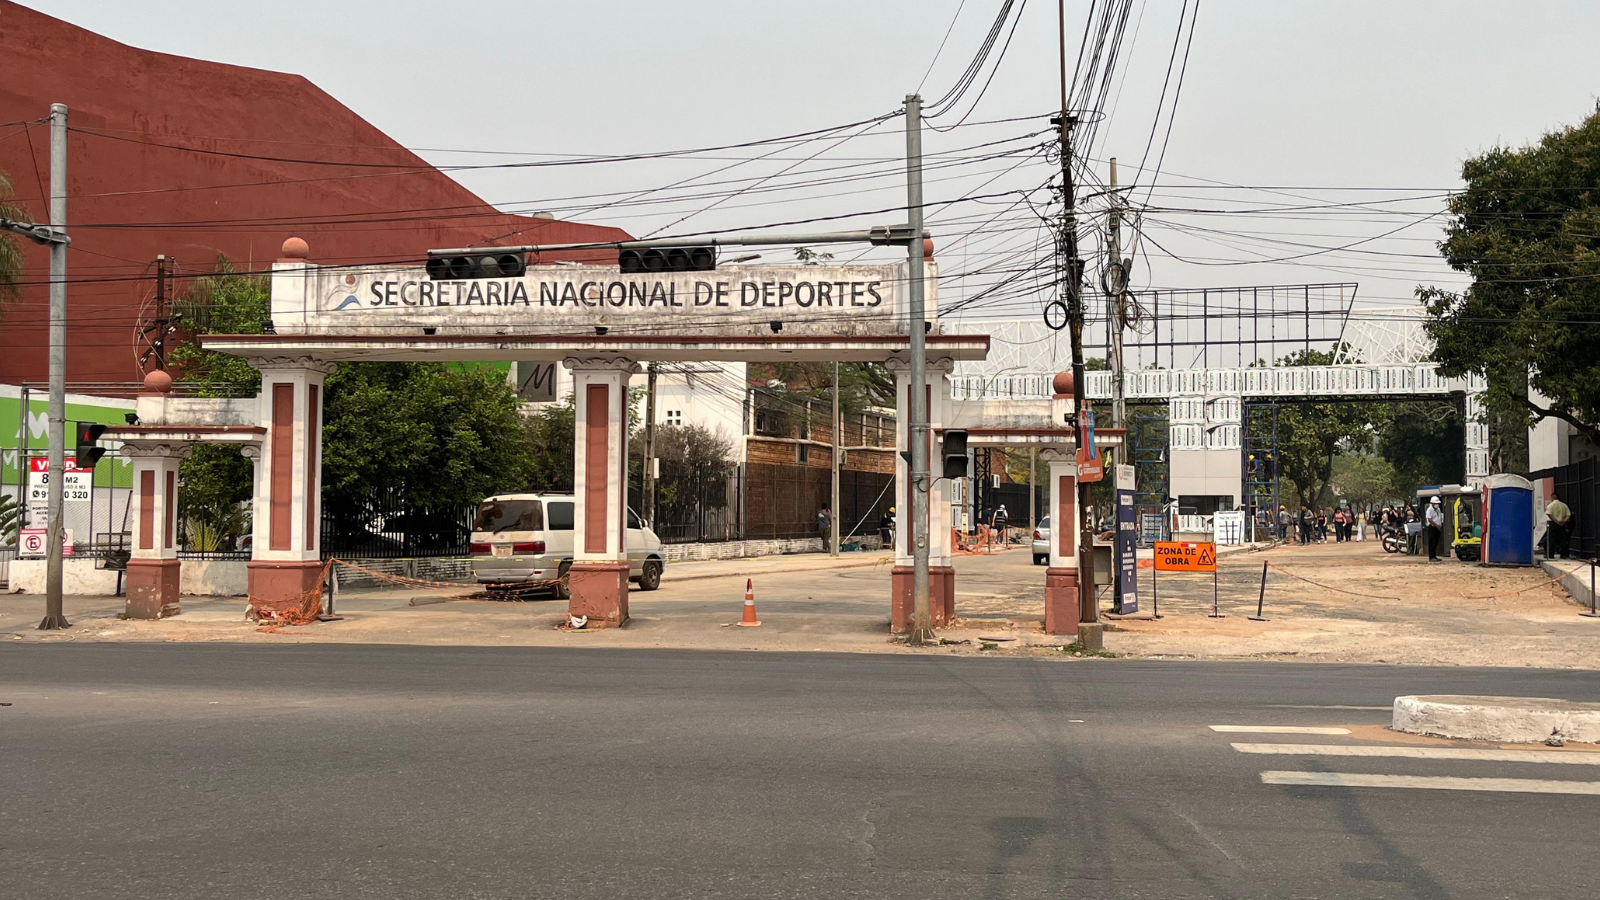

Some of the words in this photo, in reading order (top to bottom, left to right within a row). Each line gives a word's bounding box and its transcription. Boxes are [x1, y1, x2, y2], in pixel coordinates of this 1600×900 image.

[370, 281, 530, 306] SECRETARIA
[540, 281, 682, 307] NACIONAL
[695, 281, 729, 306] DE
[741, 281, 882, 307] DEPORTES
[72, 491, 88, 499] 320
[1157, 547, 1182, 555] ZONA
[1165, 557, 1189, 565] OBRA
